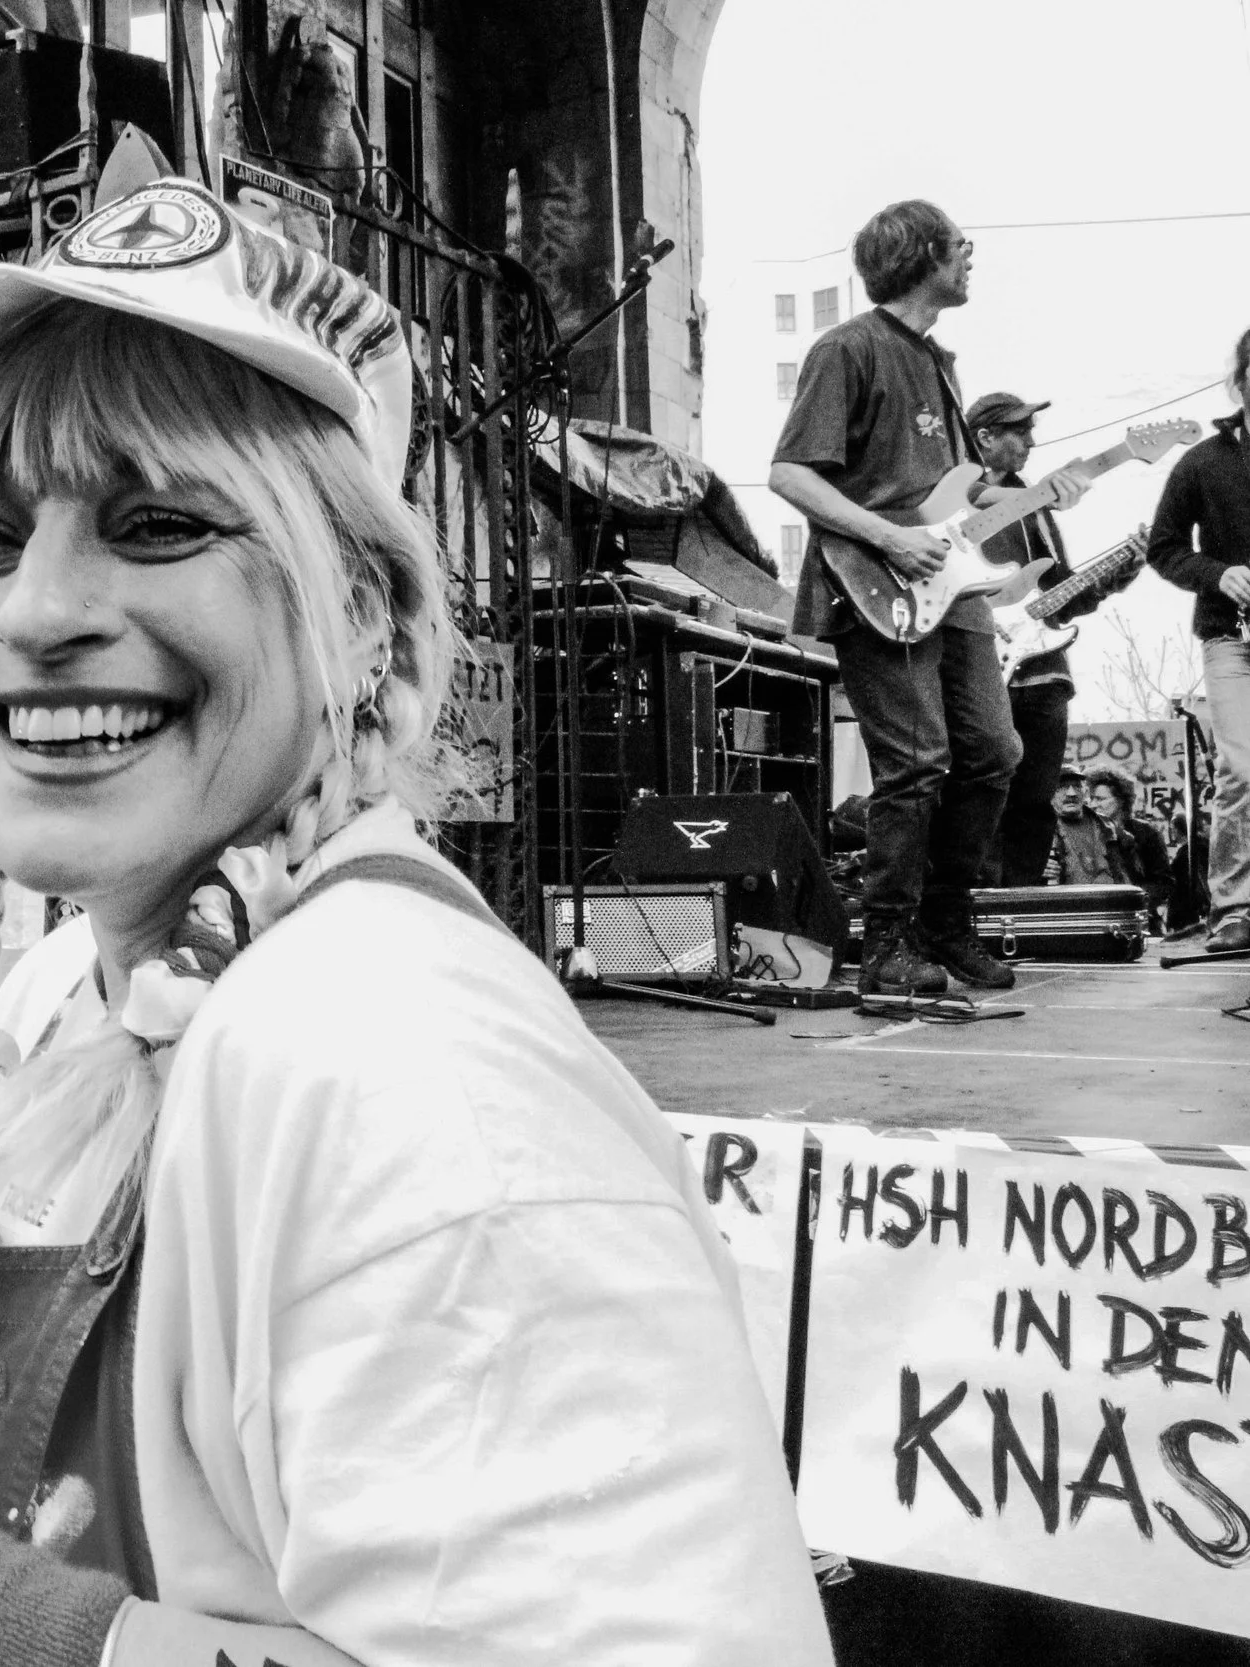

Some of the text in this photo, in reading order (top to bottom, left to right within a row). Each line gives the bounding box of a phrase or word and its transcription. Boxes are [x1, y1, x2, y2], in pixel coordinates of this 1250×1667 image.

[97, 250, 161, 263] BENZ
[837, 1161, 1250, 1288] HSH NORDB
[992, 1287, 1250, 1395] IN DEN
[893, 1363, 1250, 1569] KNAS
